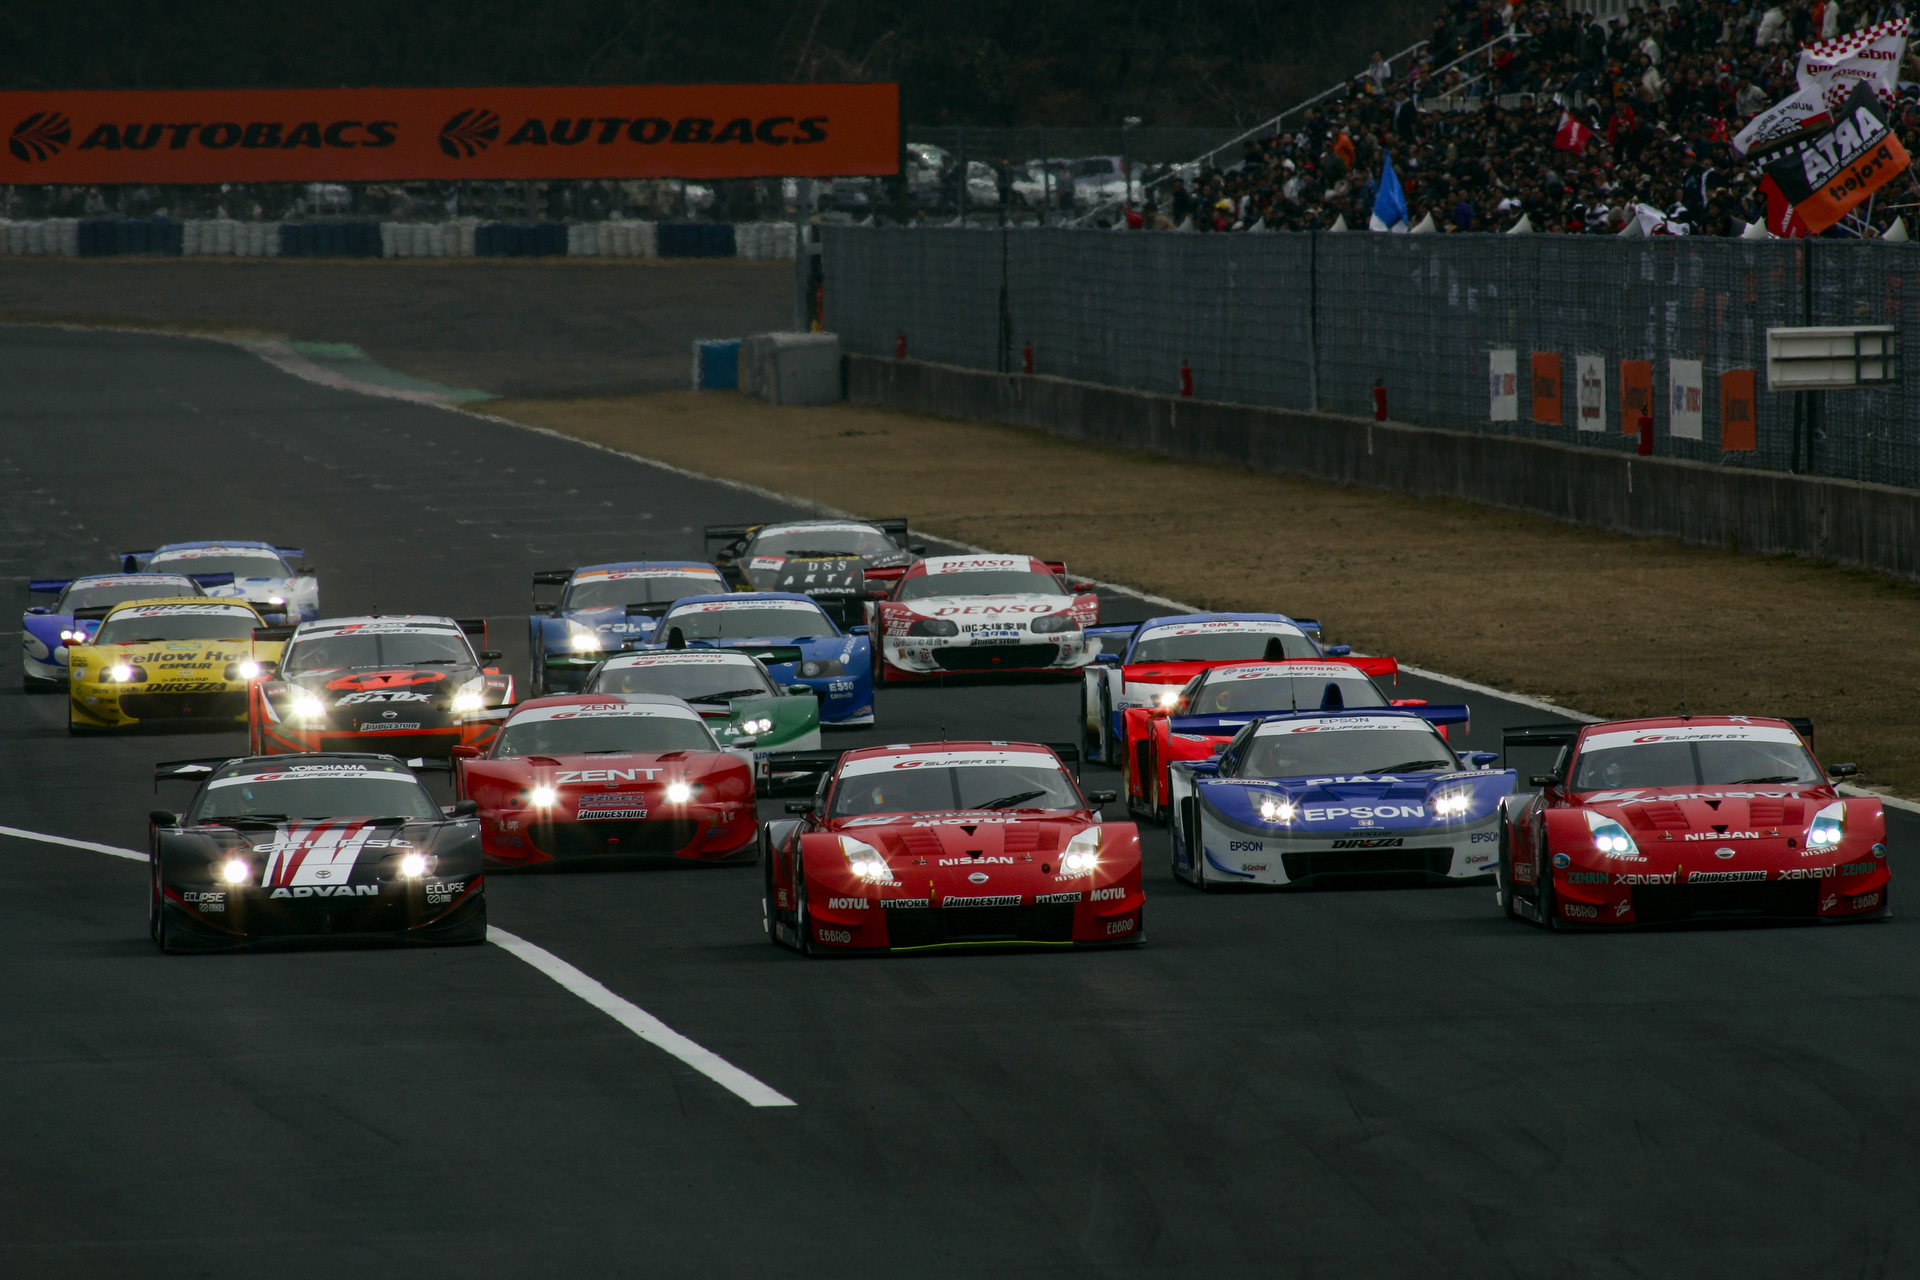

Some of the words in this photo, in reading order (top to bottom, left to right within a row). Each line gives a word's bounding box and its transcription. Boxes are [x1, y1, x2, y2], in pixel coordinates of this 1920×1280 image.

[78, 121, 398, 149] AUTOBACS
[506, 116, 828, 145] AUTOBACS
[942, 560, 1015, 569] DENSO
[936, 604, 1053, 616] DENSO
[144, 683, 228, 693] DIREZZA
[828, 681, 854, 692] ESSO
[289, 764, 367, 772] YOKOHAMA
[555, 768, 664, 784] ZENT
[1305, 775, 1405, 786] PIAA
[577, 809, 647, 820] BRIDGESTONE
[1303, 806, 1425, 821] EPSON
[912, 818, 1022, 827] MOTUL
[1684, 832, 1760, 841] NISSAN
[1230, 841, 1262, 851] EPSON
[1332, 838, 1404, 848] DIREZZA
[1606, 852, 1648, 862] nismo
[1800, 845, 1838, 857] nismo
[938, 856, 1014, 866] NISSAN
[1777, 863, 1836, 880] xanavi
[1841, 861, 1876, 876] ZENRIN
[860, 878, 902, 887] nismo
[1054, 871, 1093, 882] nismo
[1567, 872, 1609, 884] ZENRIN
[1614, 871, 1677, 885] xanavi
[1688, 870, 1767, 884] BRIDGESTONE
[269, 884, 379, 899] ADVAN
[426, 882, 465, 894] ECLIPSE
[1090, 887, 1126, 901] MOTUL
[183, 891, 226, 902] ECLIPSE
[943, 895, 1022, 908] BRIDGESTONE
[1853, 893, 1880, 909] EBBRO
[828, 897, 870, 909] MOTUL
[1565, 903, 1597, 918] EBBRO
[1107, 918, 1134, 935] EBBRO
[819, 929, 851, 943] EBBRO
